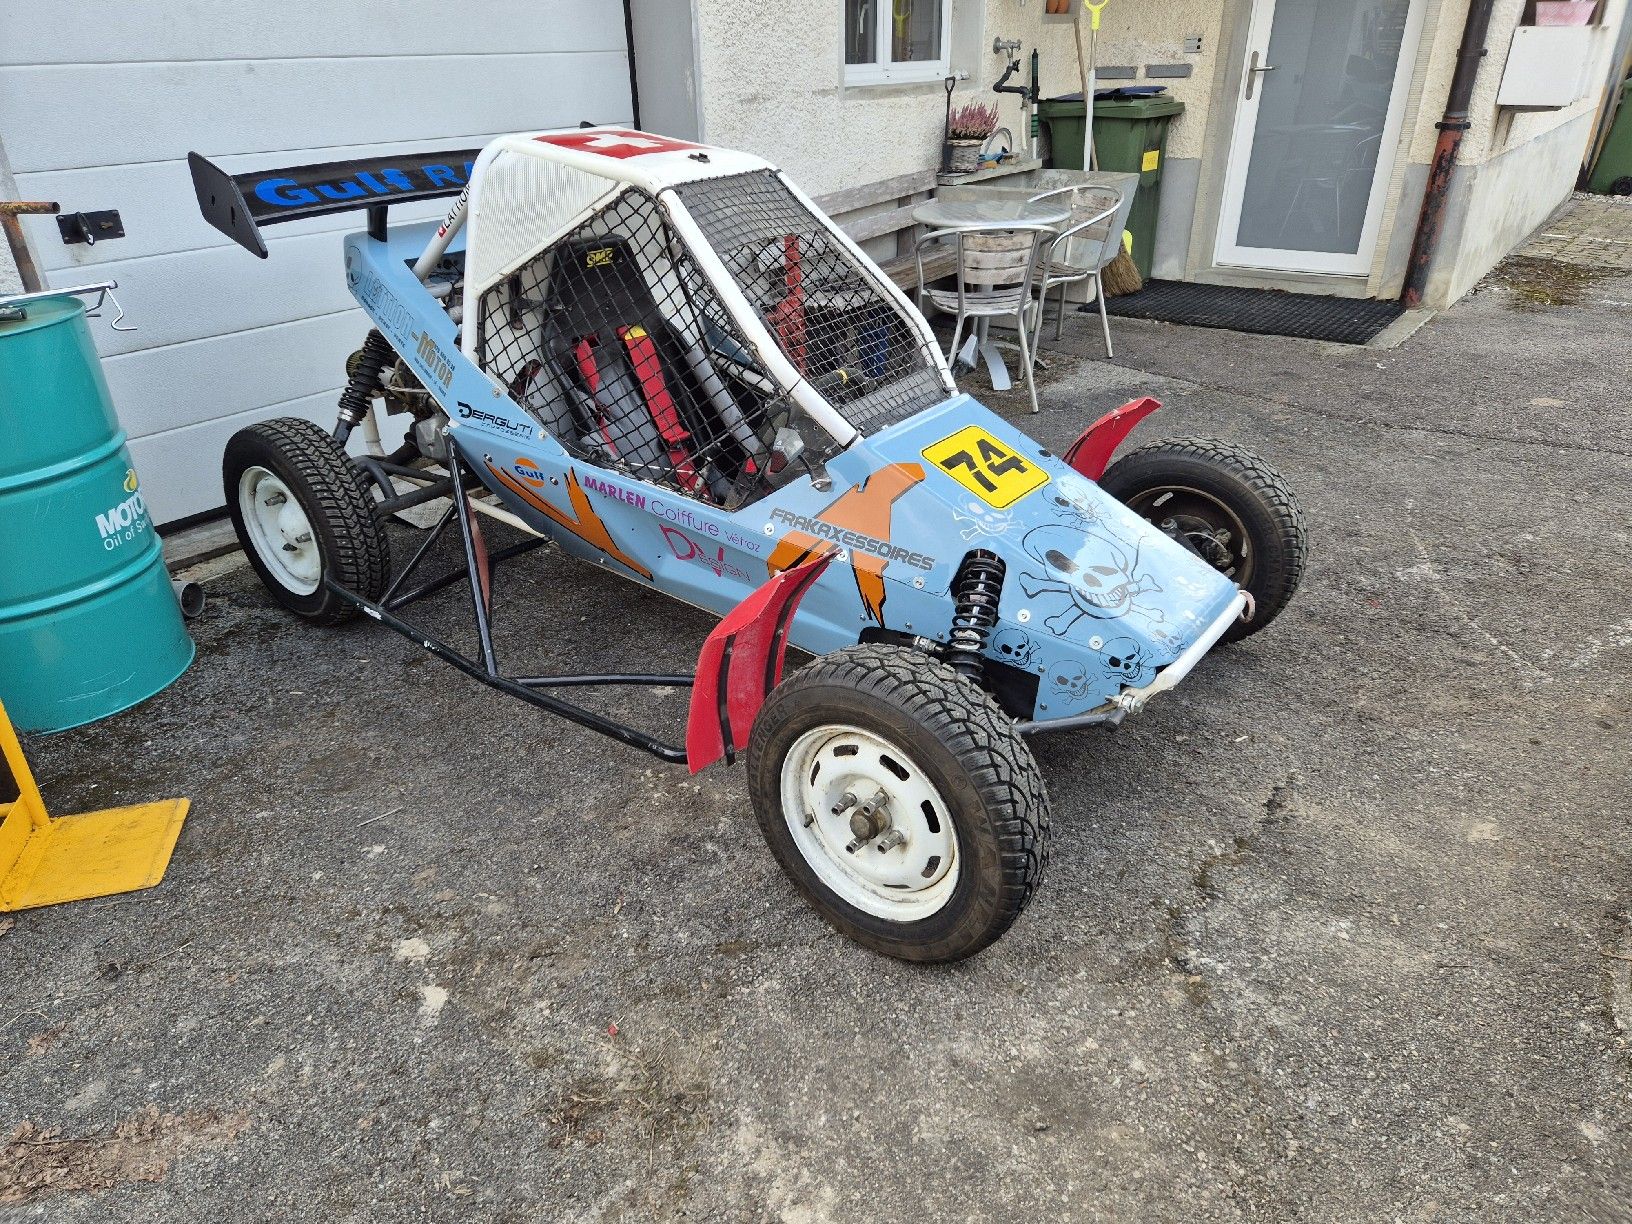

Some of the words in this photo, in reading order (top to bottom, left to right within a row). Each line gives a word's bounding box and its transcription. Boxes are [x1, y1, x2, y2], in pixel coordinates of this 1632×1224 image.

[255, 169, 415, 206] Gulf
[457, 401, 533, 436] DERGUTI
[514, 466, 544, 481] Gulf
[940, 438, 1028, 493] 74
[95, 491, 147, 538] MOTO
[584, 475, 646, 510] MARLEN
[652, 499, 719, 537] Coiffure
[104, 533, 123, 551] Oil
[125, 525, 135, 540] of
[768, 506, 936, 572] FRAKAXESSOIRES
